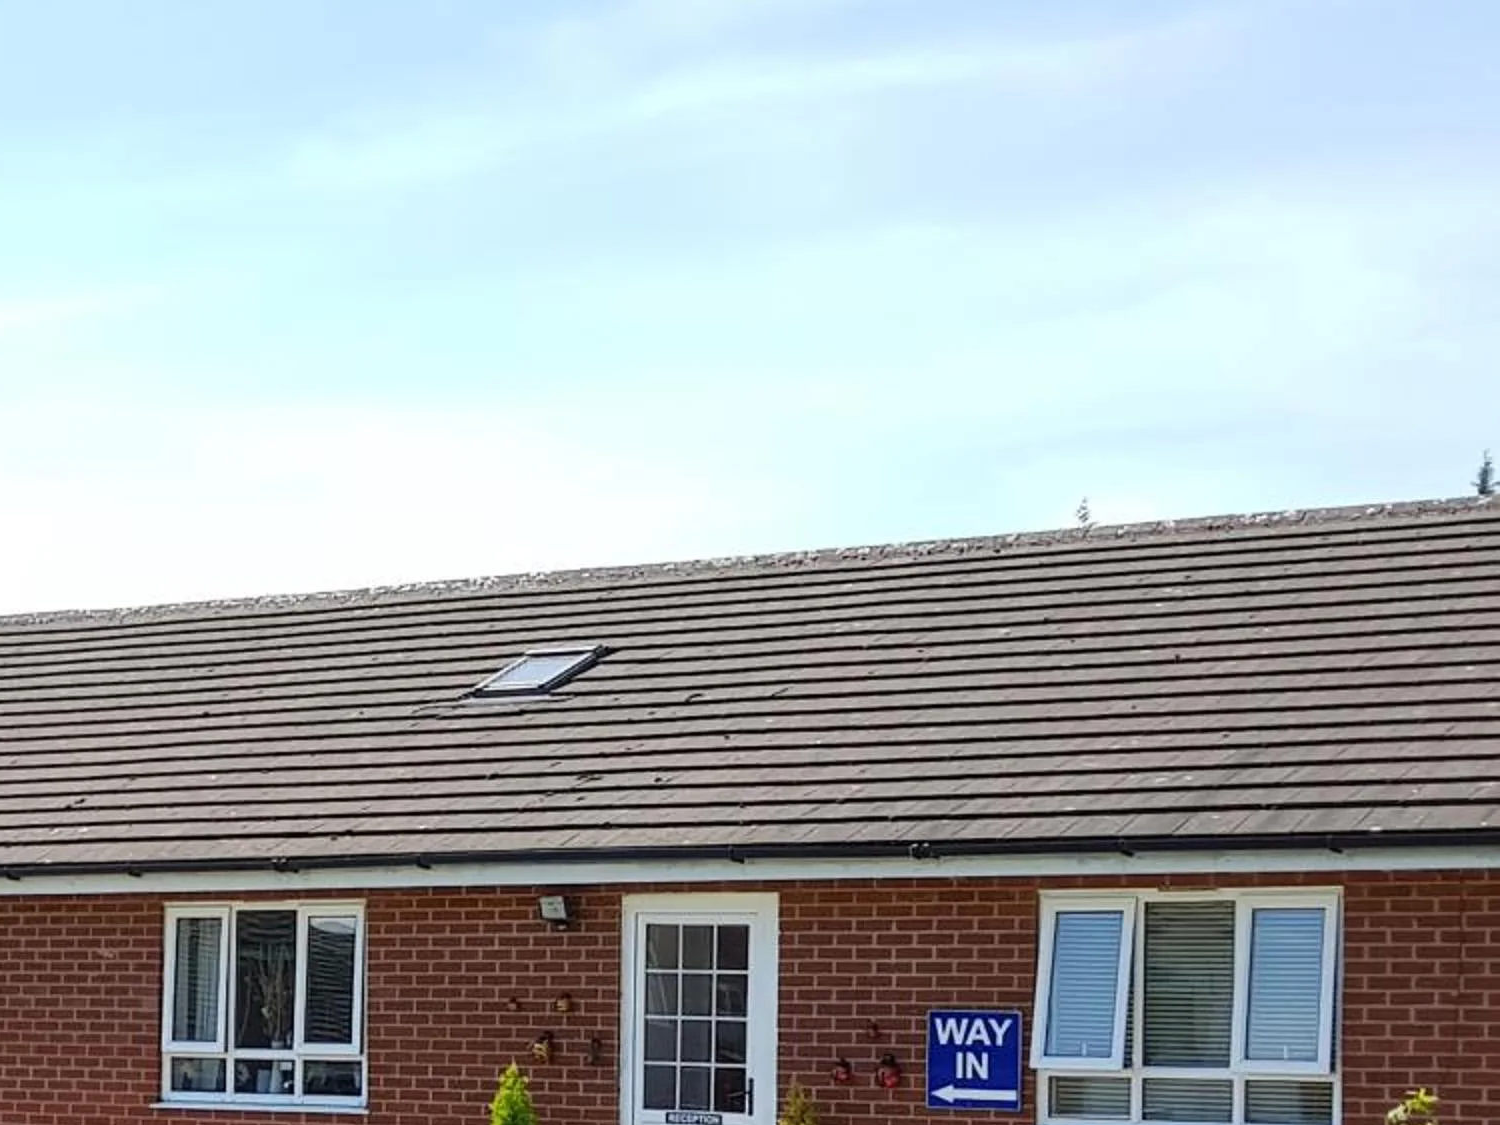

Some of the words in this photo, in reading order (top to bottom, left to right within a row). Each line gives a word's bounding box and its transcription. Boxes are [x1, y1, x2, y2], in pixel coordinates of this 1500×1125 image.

[934, 1017, 1013, 1047] WAY
[955, 1051, 989, 1080] IN
[668, 1112, 721, 1125] RECEPTION
